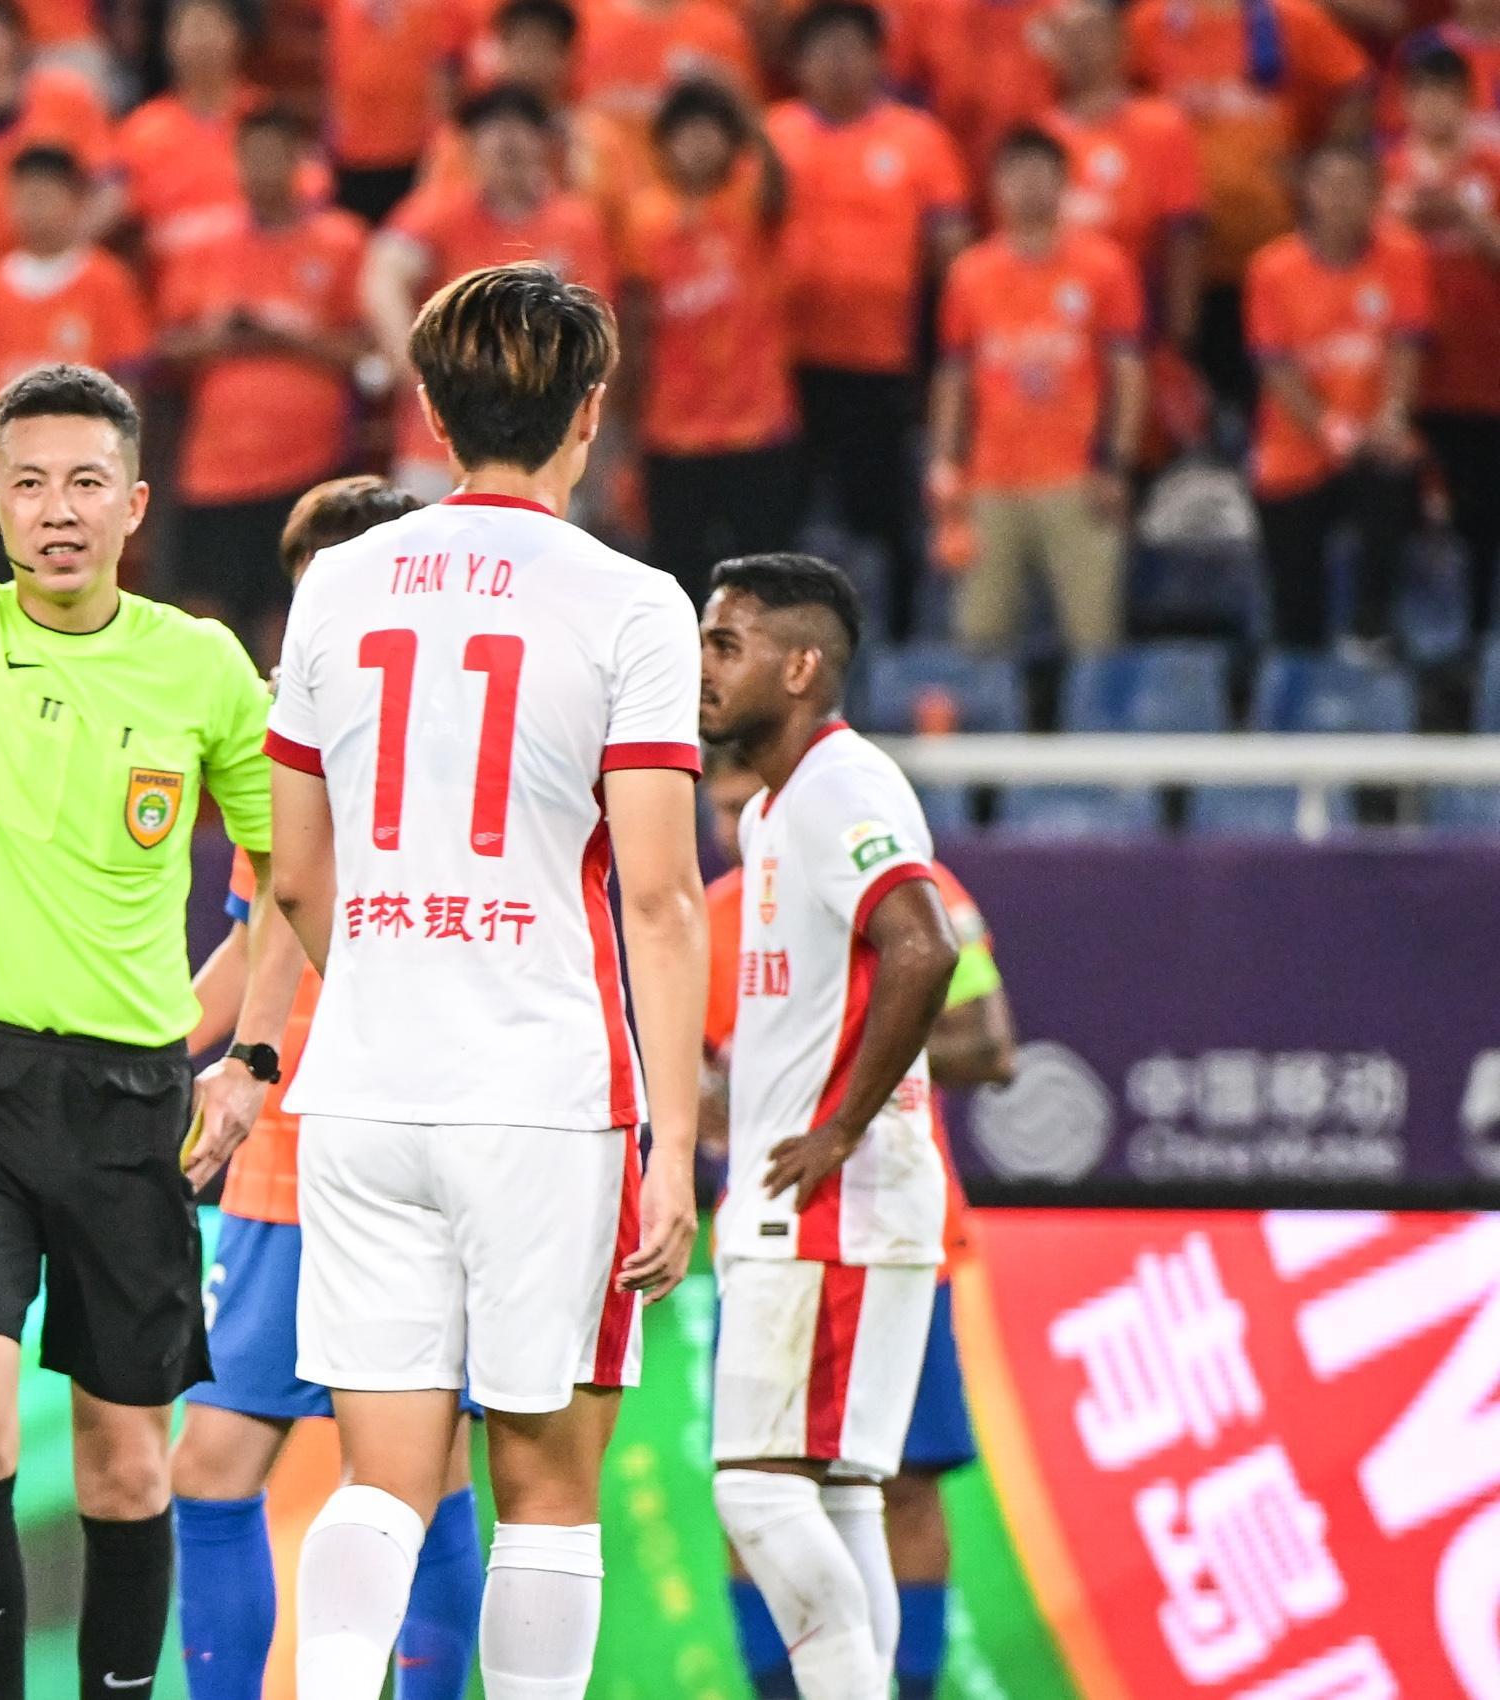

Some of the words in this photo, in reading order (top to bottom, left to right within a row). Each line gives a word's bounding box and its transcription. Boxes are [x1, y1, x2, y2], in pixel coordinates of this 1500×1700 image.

[390, 553, 451, 595] TIAN
[465, 553, 515, 599] Y.D.
[358, 628, 526, 858] 11
